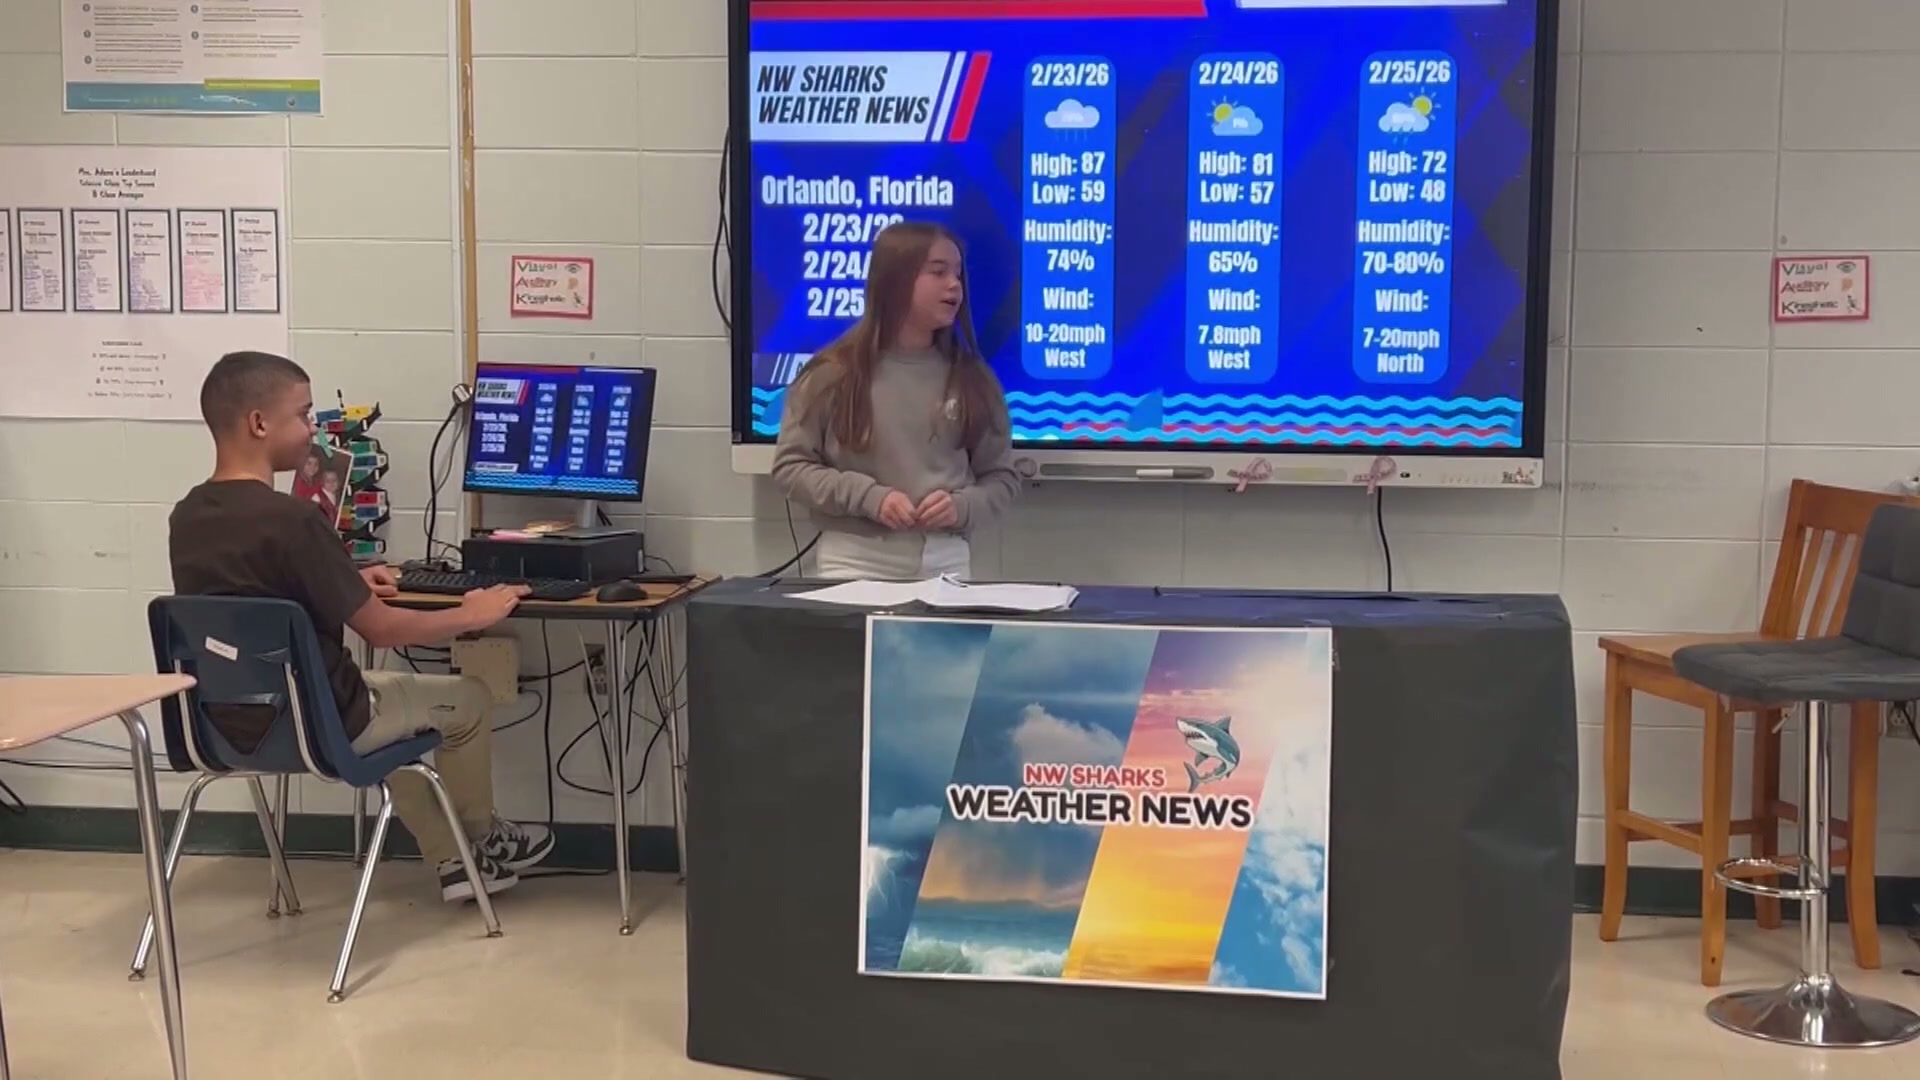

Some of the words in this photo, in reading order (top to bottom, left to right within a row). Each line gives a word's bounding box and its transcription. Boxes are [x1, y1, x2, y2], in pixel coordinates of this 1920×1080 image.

[757, 65, 793, 92] NW
[800, 65, 888, 92] SHARKS
[1031, 63, 1109, 86] 2/23/26
[1199, 61, 1278, 84] 2/24/26
[1368, 60, 1451, 83] 2/25/26
[758, 96, 865, 124] WEATHER
[866, 96, 930, 124] NEWS
[1031, 153, 1077, 177] High:
[1081, 152, 1105, 174] 87
[1199, 152, 1247, 175] High:
[1252, 152, 1274, 174] 81
[1368, 151, 1417, 175] High:
[1422, 151, 1447, 173] 72
[761, 175, 863, 208] Orlando,
[869, 176, 954, 206] Florida
[1032, 183, 1075, 204] Low:
[1080, 181, 1105, 202] 59
[1200, 182, 1244, 203] Low:
[1250, 181, 1275, 204] 57
[1369, 180, 1415, 202] Low:
[1420, 179, 1446, 202] 48
[803, 213, 904, 243] 2/23/2
[1024, 219, 1113, 243] Humidity:
[1189, 220, 1279, 245] Humidity:
[1358, 220, 1450, 246] Humidity:
[1047, 249, 1095, 271] 74%
[1208, 251, 1258, 274] 65%
[1362, 251, 1445, 274] 70-80%
[1043, 287, 1094, 311] Wind:
[1208, 288, 1260, 311] Wind:
[1375, 289, 1429, 312] Wind:
[1025, 323, 1105, 345] 10-20mph
[1198, 325, 1262, 347] 7.8mph
[1363, 328, 1440, 350] 7-20mph
[1045, 349, 1086, 368] West
[1208, 350, 1250, 370] West
[1377, 353, 1424, 373] North
[1025, 765, 1065, 785] NW
[1072, 767, 1164, 787] SHARKS
[950, 788, 1131, 823] WEATHER
[1142, 795, 1250, 827] NEWS
